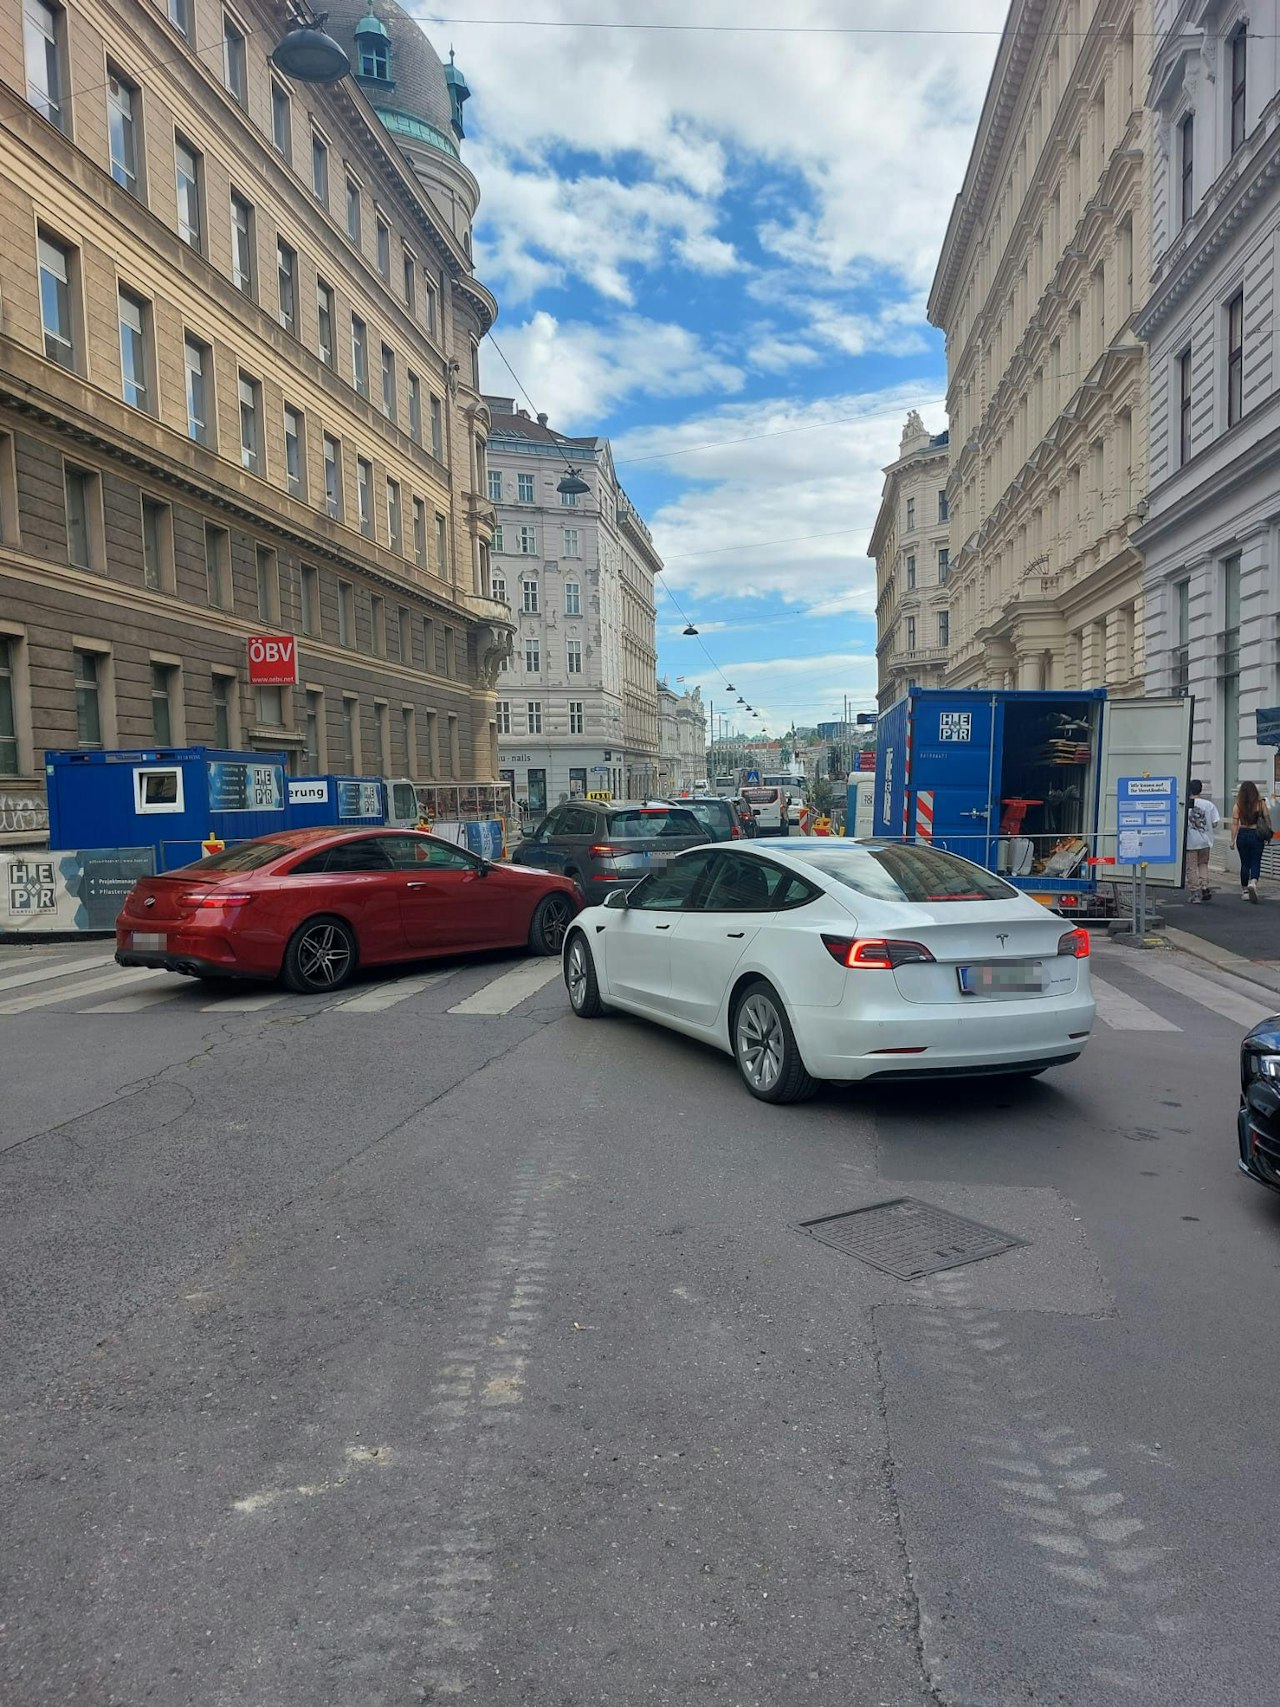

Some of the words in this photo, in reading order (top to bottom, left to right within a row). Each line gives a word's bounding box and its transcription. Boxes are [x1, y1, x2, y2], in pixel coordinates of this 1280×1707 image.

[250, 639, 292, 662] ÖBV
[511, 754, 531, 762] nails
[590, 792, 610, 800] TAXI
